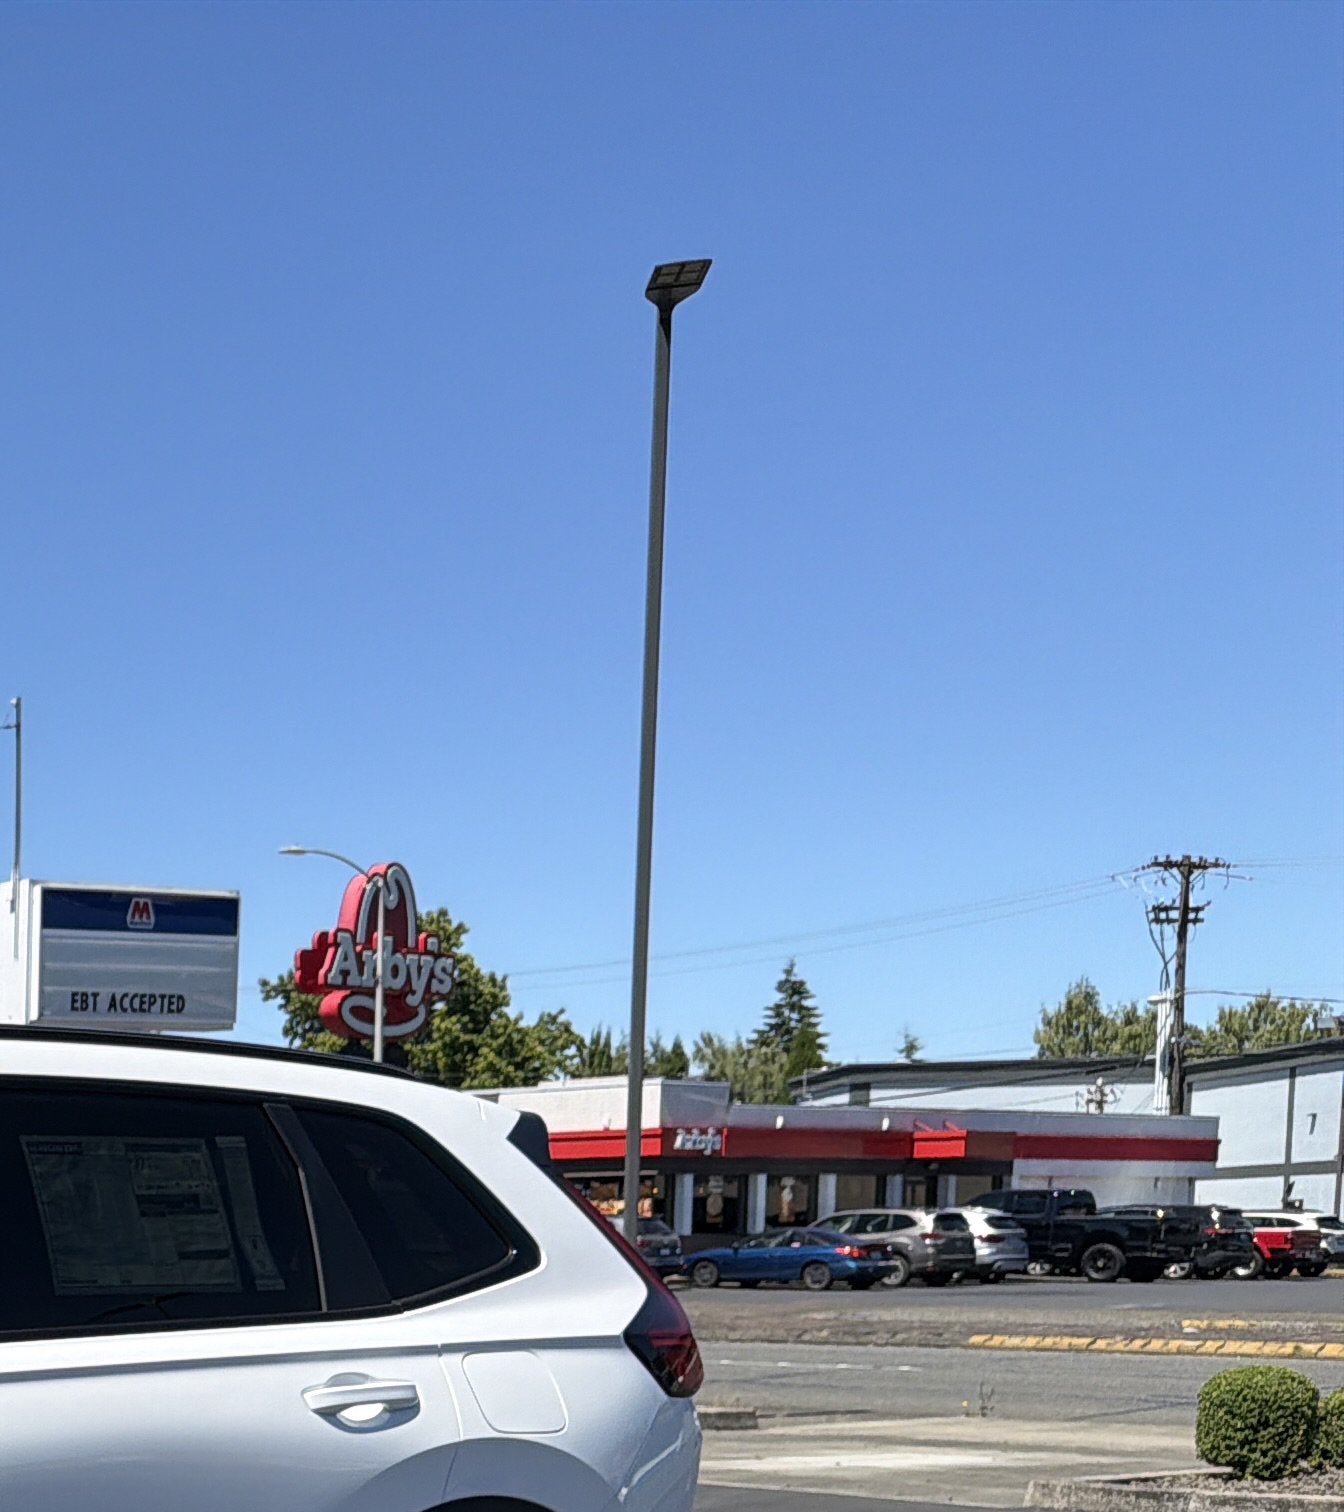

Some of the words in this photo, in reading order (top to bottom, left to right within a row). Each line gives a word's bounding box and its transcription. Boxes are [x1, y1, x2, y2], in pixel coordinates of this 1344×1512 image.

[327, 931, 454, 1007] Arby's
[70, 991, 100, 1012] EBT
[107, 992, 185, 1015] ACCEPTED
